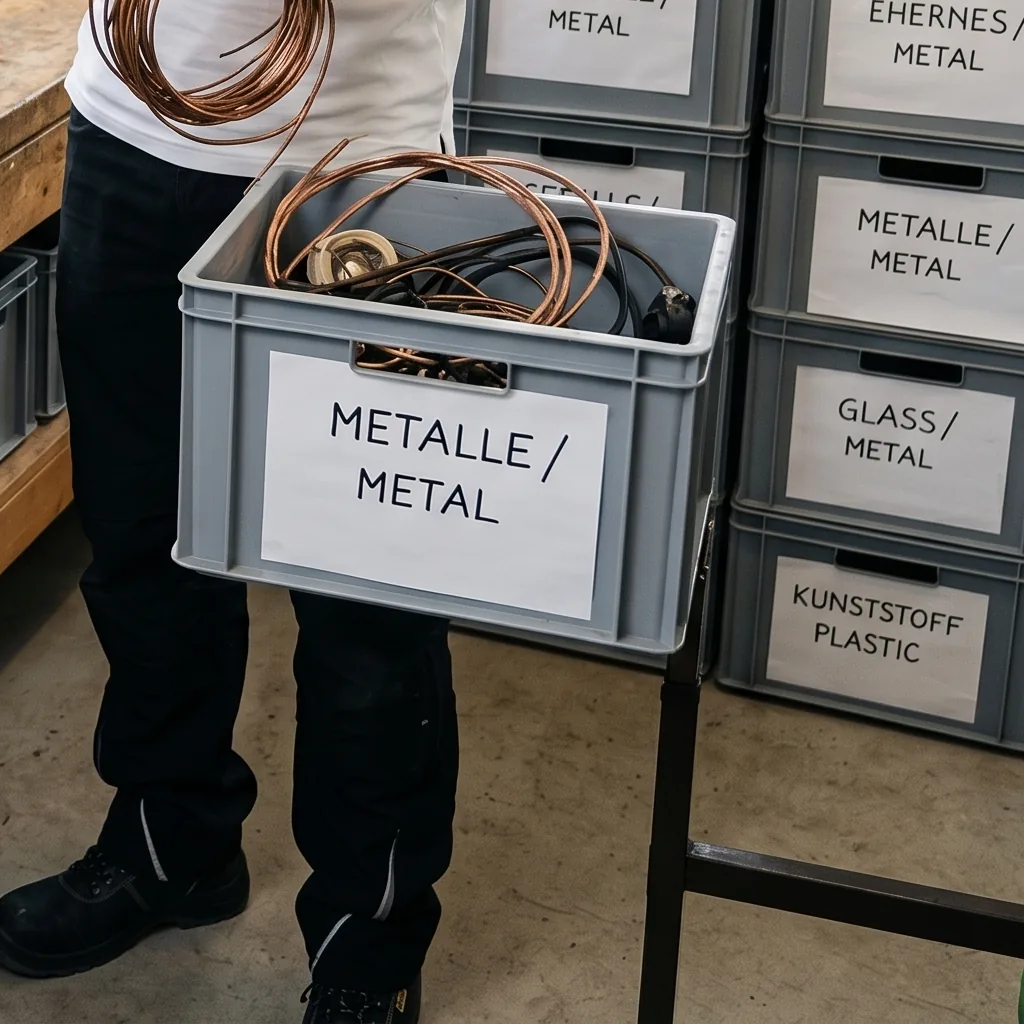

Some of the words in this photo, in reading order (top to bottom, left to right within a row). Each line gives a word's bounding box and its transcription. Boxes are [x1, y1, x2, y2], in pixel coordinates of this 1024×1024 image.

[548, 9, 630, 37] METAL
[893, 42, 984, 72] METAL
[870, 249, 961, 282] METAL
[844, 435, 933, 470] METAL
[357, 467, 500, 524] METAL
[792, 583, 964, 636] KUNSTSTOFF
[814, 622, 920, 664] PLASTIC
